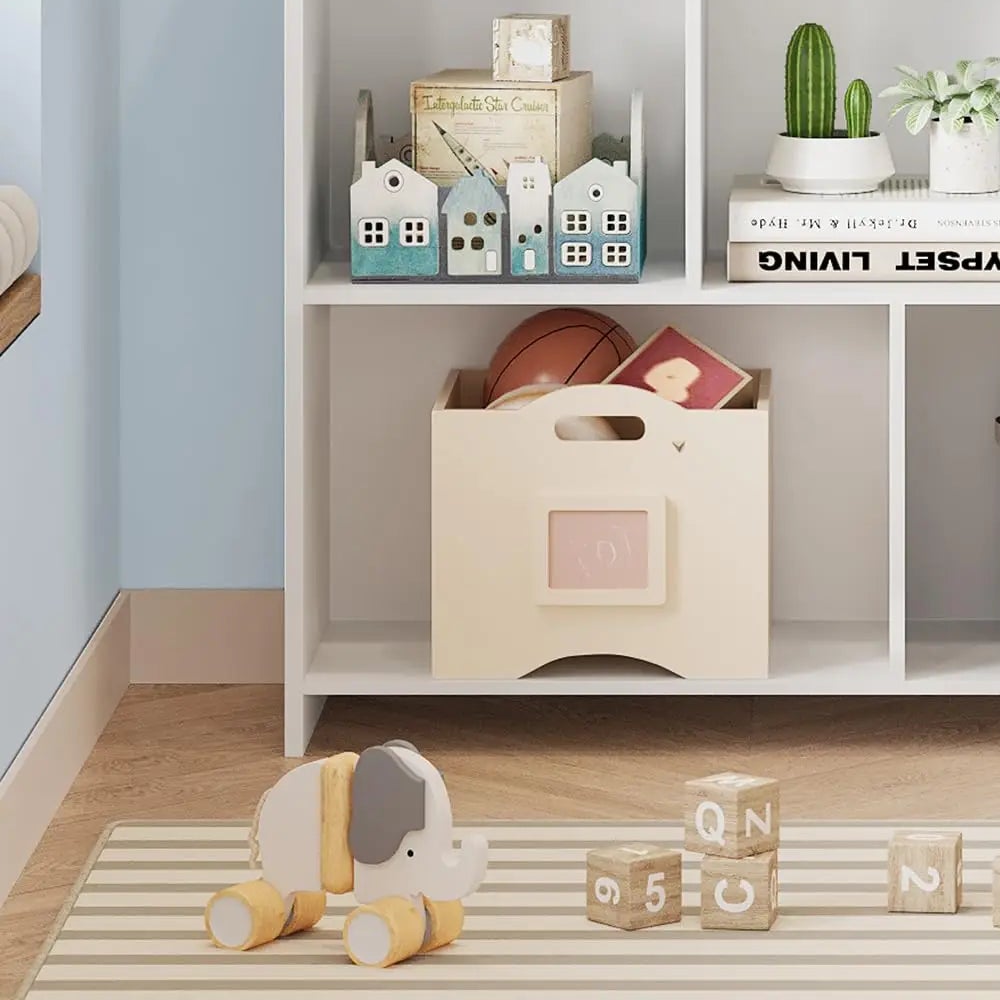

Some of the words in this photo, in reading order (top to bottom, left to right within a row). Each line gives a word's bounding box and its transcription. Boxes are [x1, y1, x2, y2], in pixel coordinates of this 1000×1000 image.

[422, 94, 483, 118] Intergalactic
[484, 95, 509, 113] Star
[750, 218, 789, 229] Hyde
[797, 218, 821, 229] Mr.
[759, 251, 870, 271] LIVING
[695, 801, 726, 846] Q
[645, 872, 666, 912] 5
[714, 878, 755, 913] C
